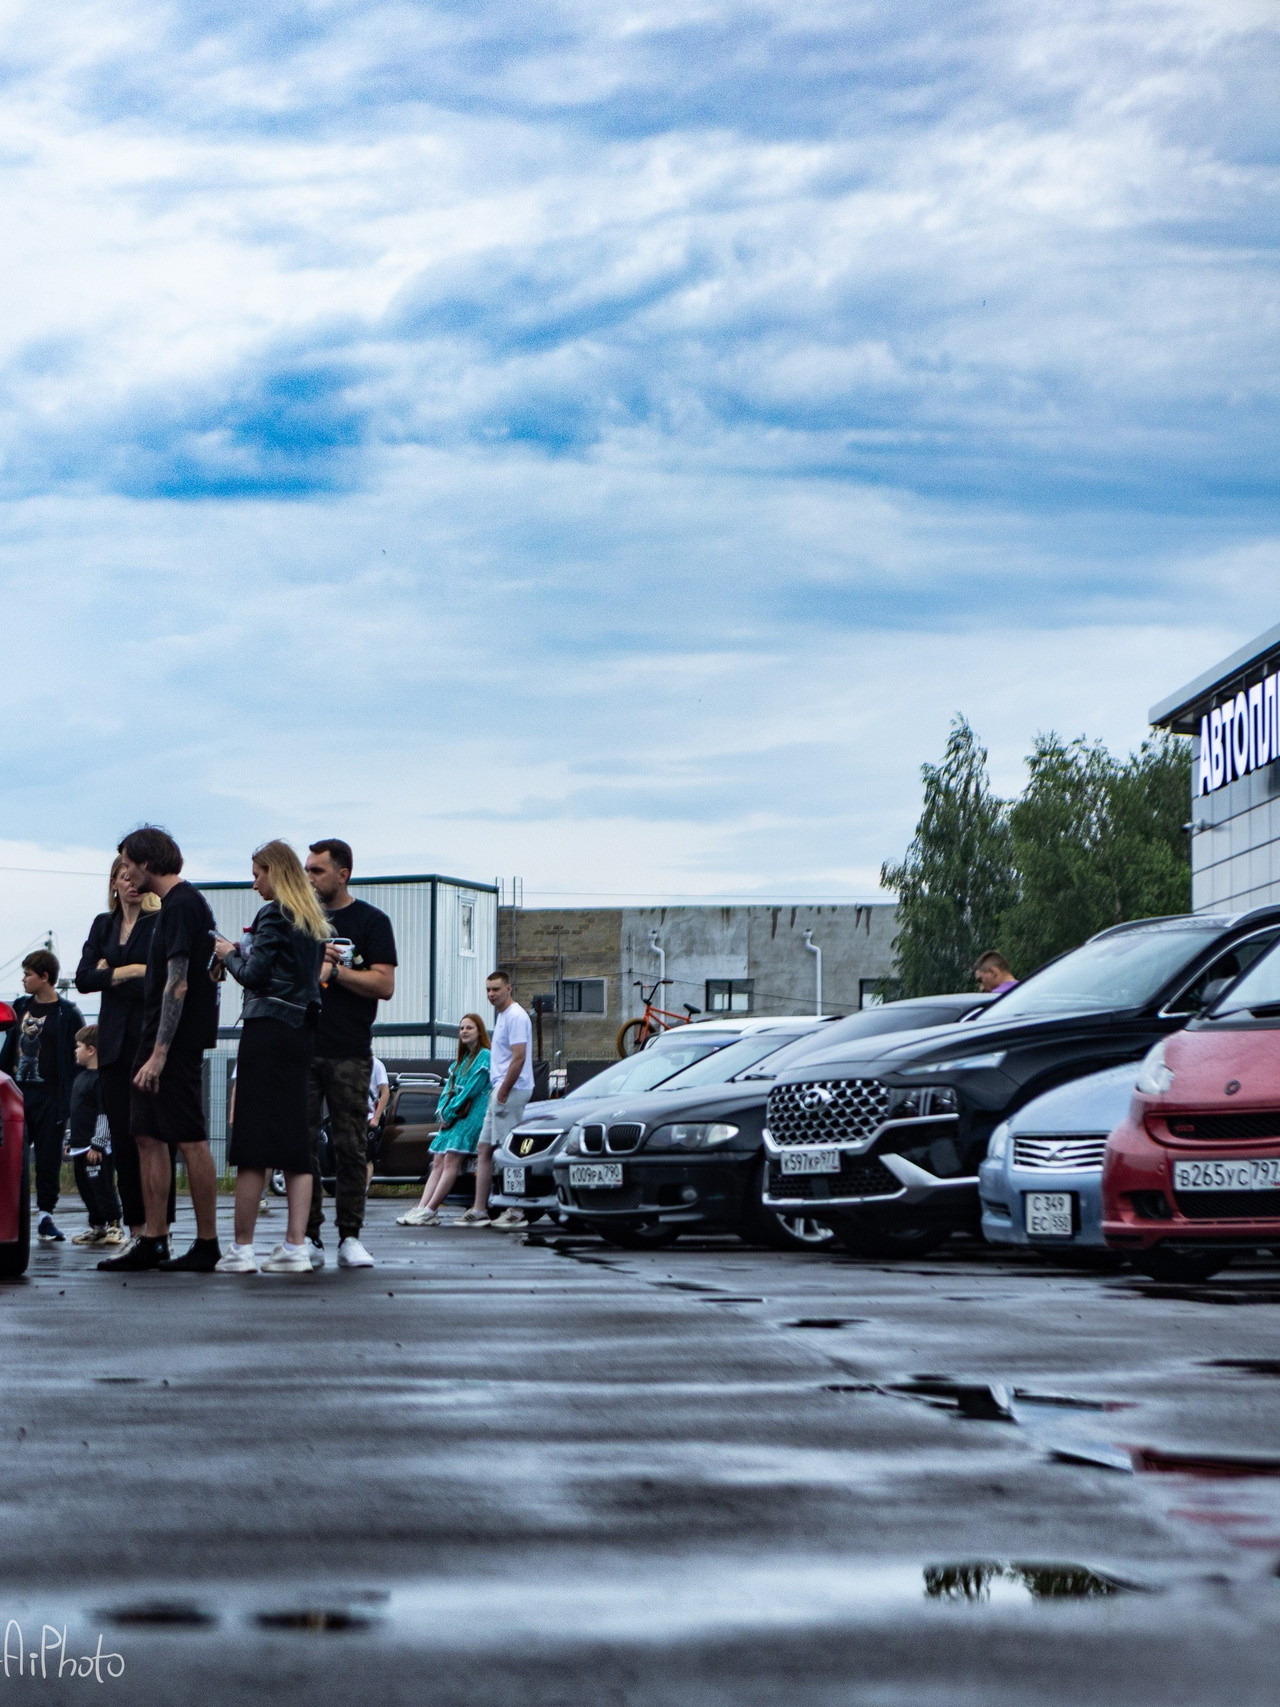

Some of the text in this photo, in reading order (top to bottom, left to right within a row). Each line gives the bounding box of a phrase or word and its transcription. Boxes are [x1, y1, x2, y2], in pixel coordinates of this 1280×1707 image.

[1198, 669, 1280, 797] АВТОПЛ
[1179, 1161, 1278, 1186] В265УС 797
